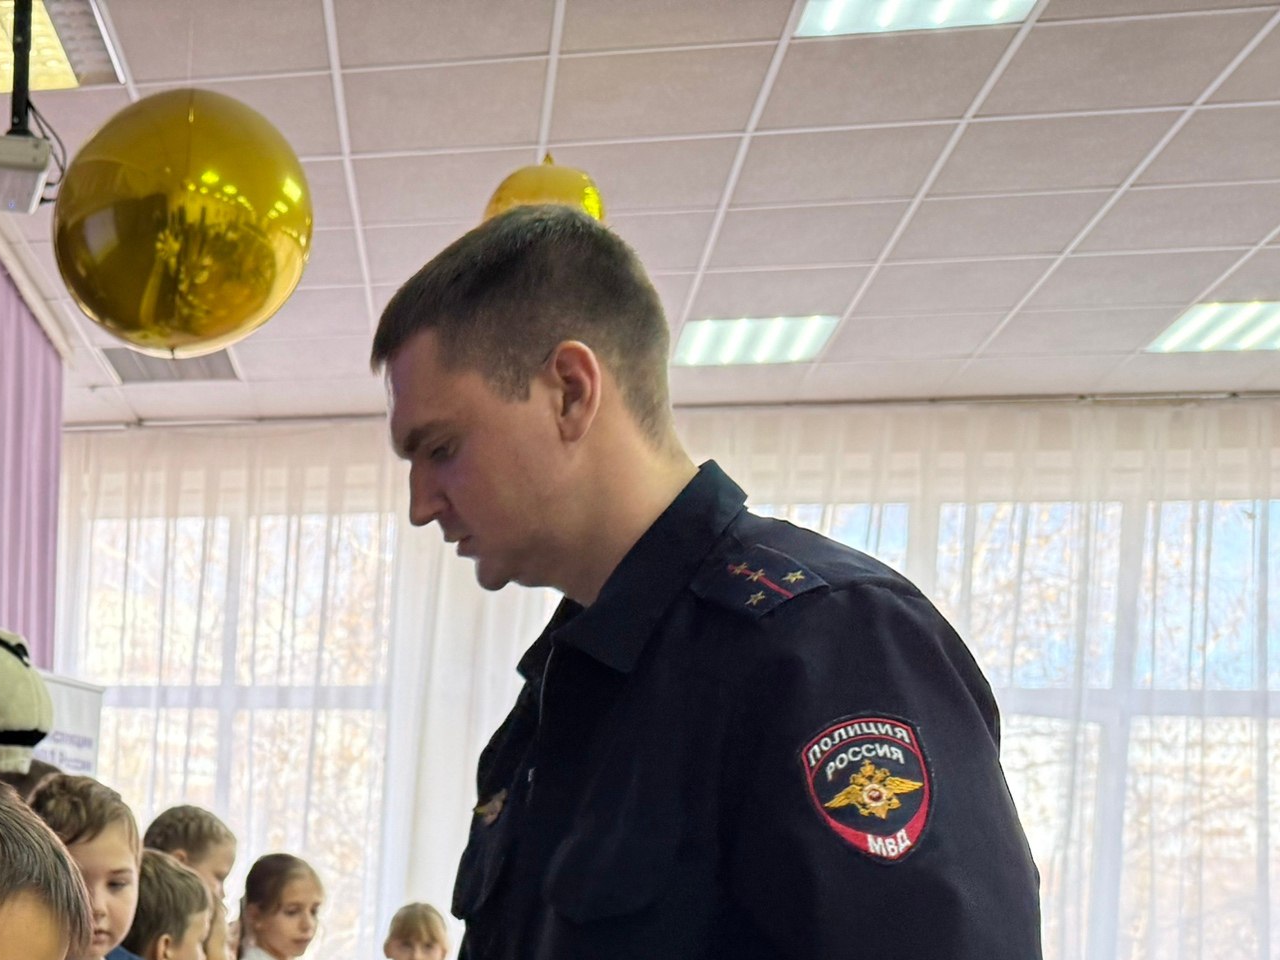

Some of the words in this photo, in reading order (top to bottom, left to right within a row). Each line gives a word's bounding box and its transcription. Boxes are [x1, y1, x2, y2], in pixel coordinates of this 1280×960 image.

[807, 722, 911, 767] ПОЛИЦИЯ
[825, 743, 904, 781] РОССИЯ
[867, 828, 912, 857] МВД
